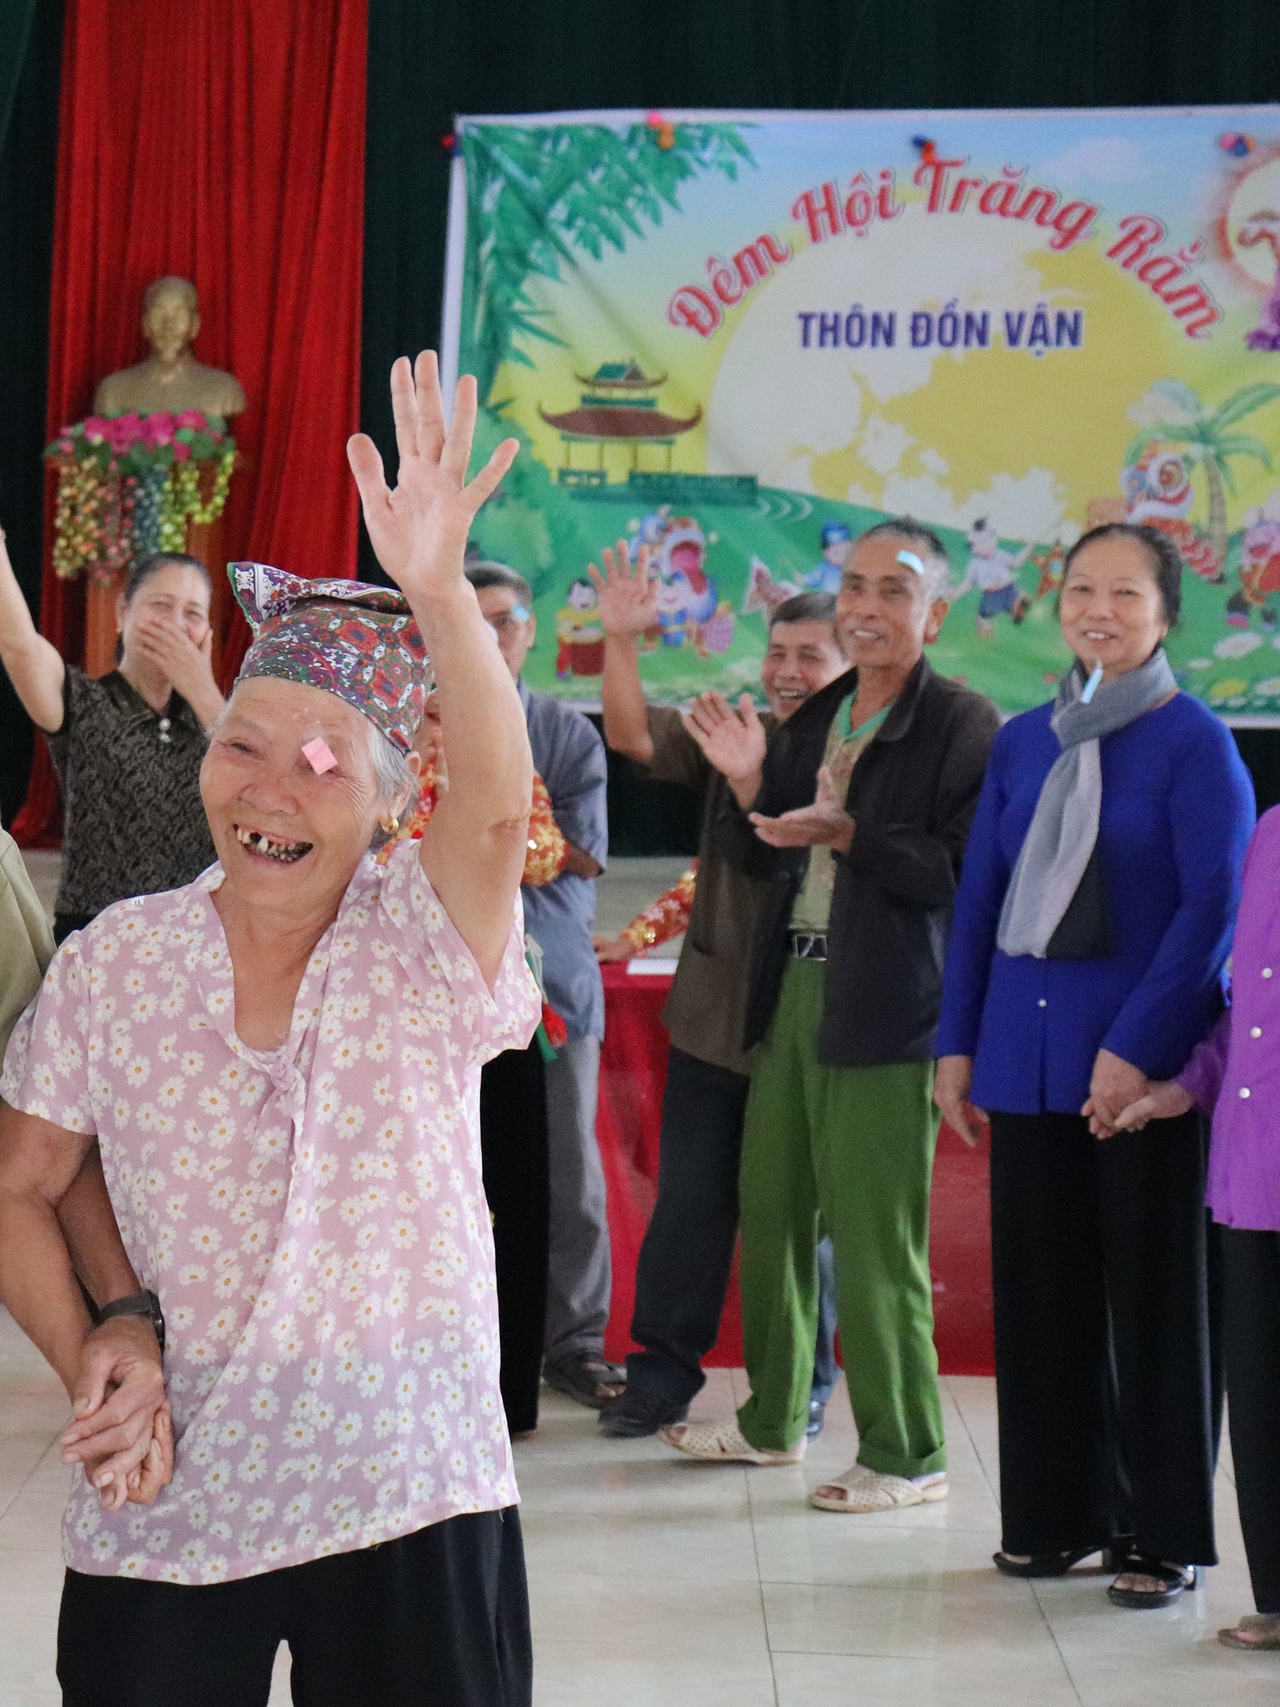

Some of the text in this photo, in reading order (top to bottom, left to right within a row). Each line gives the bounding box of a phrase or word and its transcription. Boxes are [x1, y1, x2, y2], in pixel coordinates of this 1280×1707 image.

[668, 155, 1220, 339] Đêm Hội Trăng Rằm
[798, 297, 1084, 358] THÔN ĐỒN VẬN
